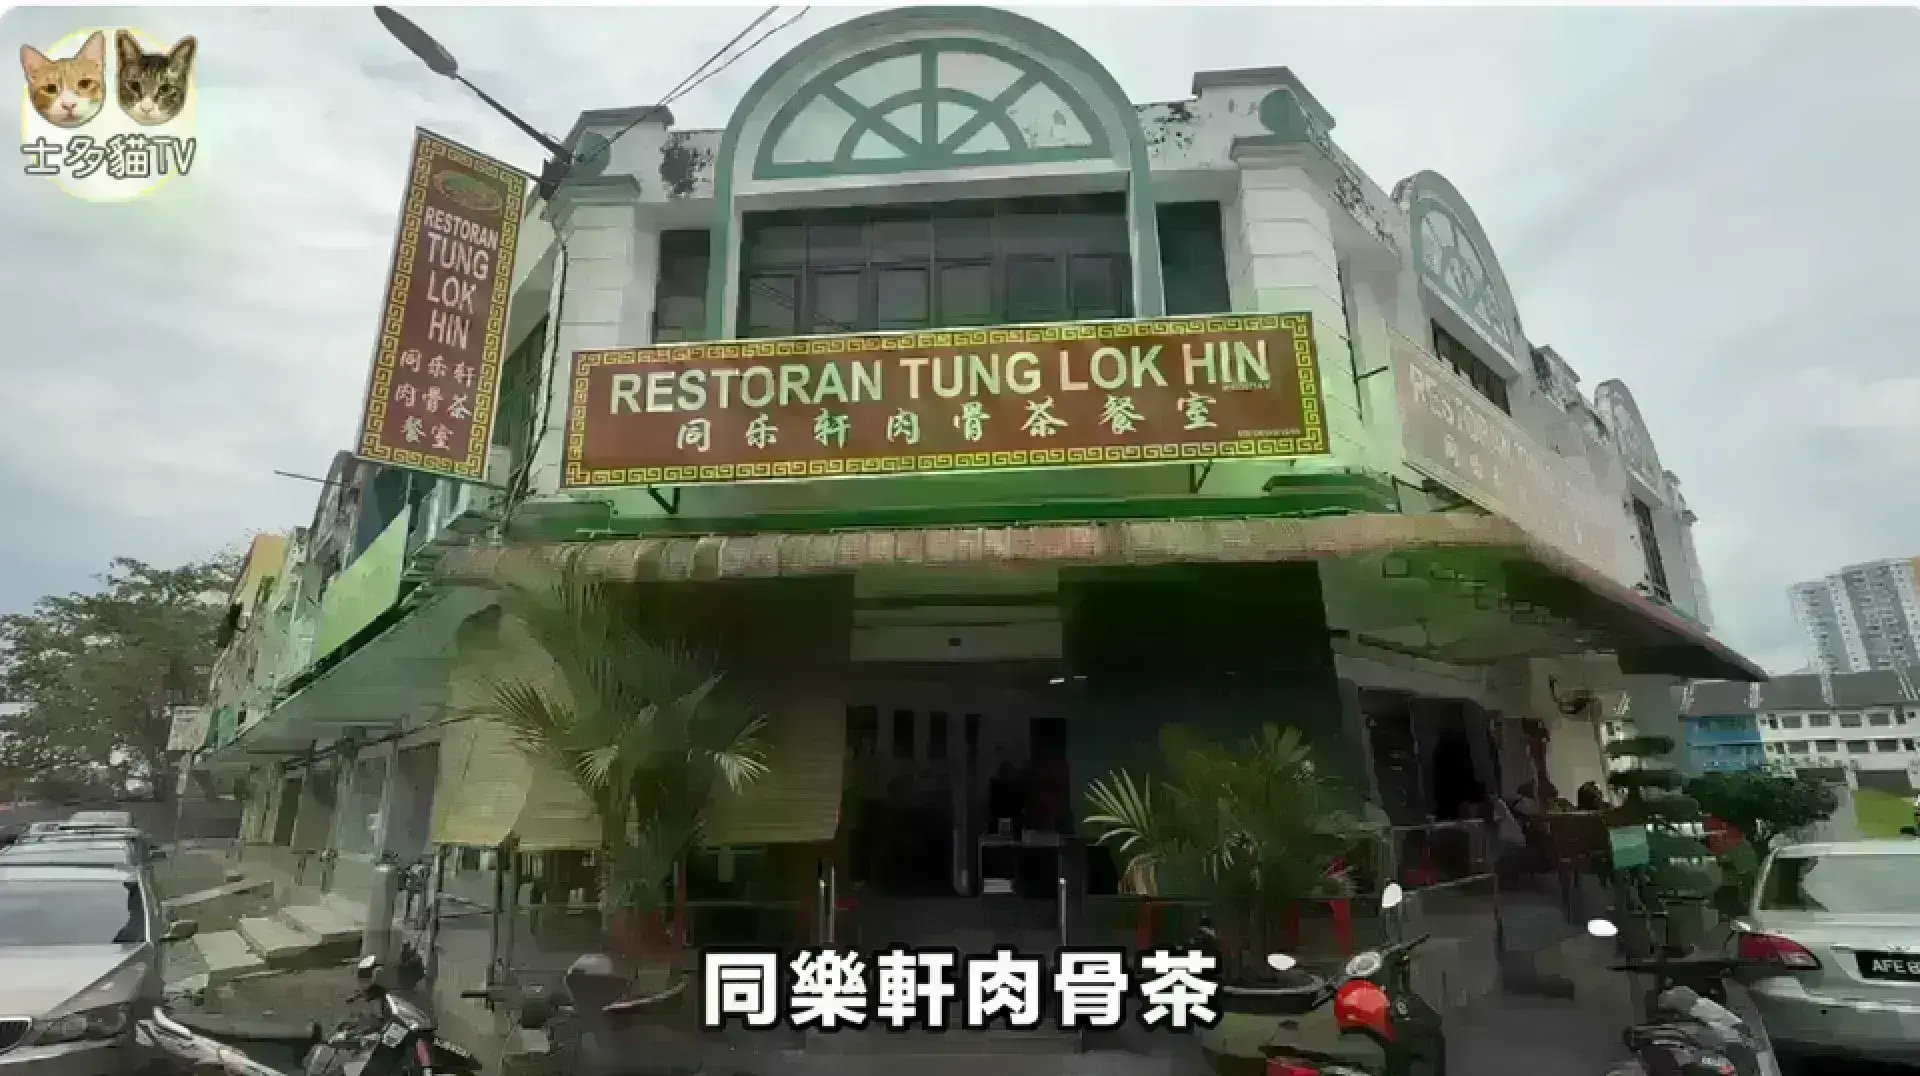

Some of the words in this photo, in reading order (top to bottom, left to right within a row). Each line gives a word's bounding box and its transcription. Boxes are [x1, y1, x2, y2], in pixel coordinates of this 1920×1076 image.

[424, 206, 499, 251] RESTORAN
[427, 231, 490, 280] TUNG
[427, 269, 477, 315] LOK
[428, 308, 470, 349] HIN
[610, 360, 882, 415] RESTORAN
[900, 351, 1041, 400] TUNG
[1060, 344, 1169, 391] LOK
[1182, 340, 1271, 385] HIN
